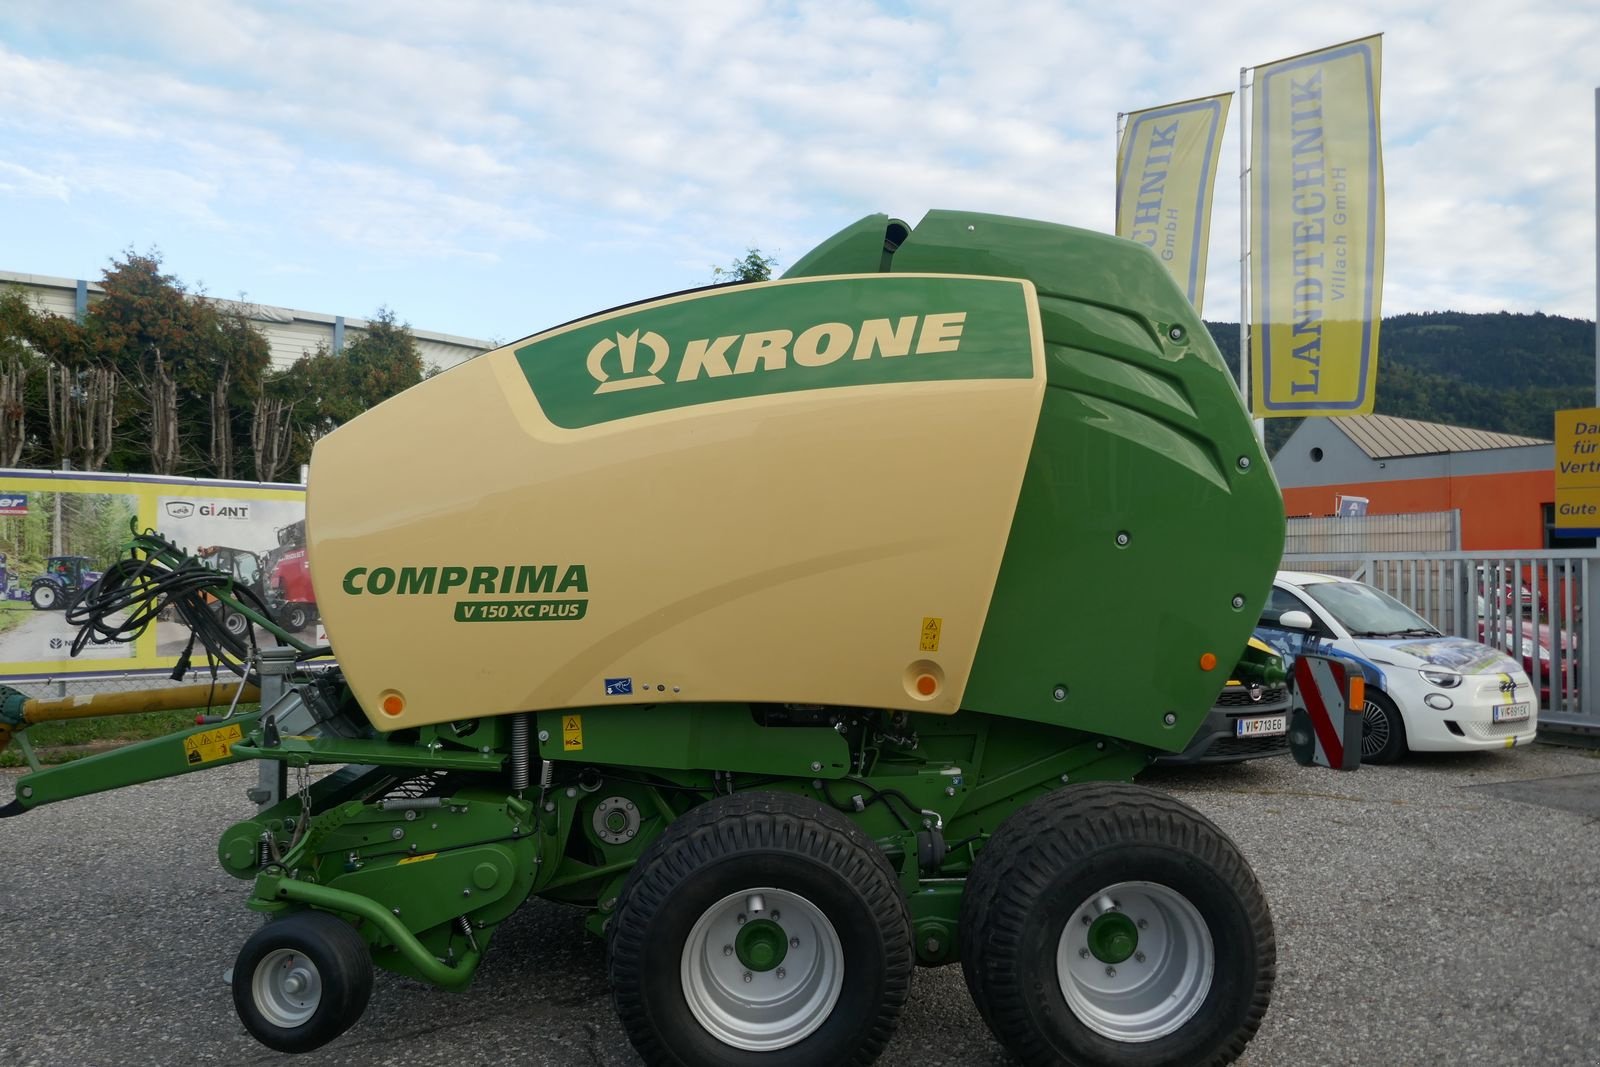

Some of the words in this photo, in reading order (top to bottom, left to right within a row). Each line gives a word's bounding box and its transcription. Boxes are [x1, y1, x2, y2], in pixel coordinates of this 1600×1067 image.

[1331, 167, 1347, 226] GmbH
[1161, 208, 1179, 261] GmbH
[1291, 68, 1326, 395] LANDTECHNIK
[1331, 235, 1347, 302] Villach
[676, 311, 967, 382] KRONE
[1573, 440, 1598, 455] für
[1575, 422, 1600, 435] Da
[1560, 503, 1597, 516] Gute
[343, 564, 589, 595] COMPRIMA
[464, 606, 475, 618] V
[480, 605, 509, 618] 150
[512, 605, 536, 618] XC
[539, 604, 580, 617] PLUS
